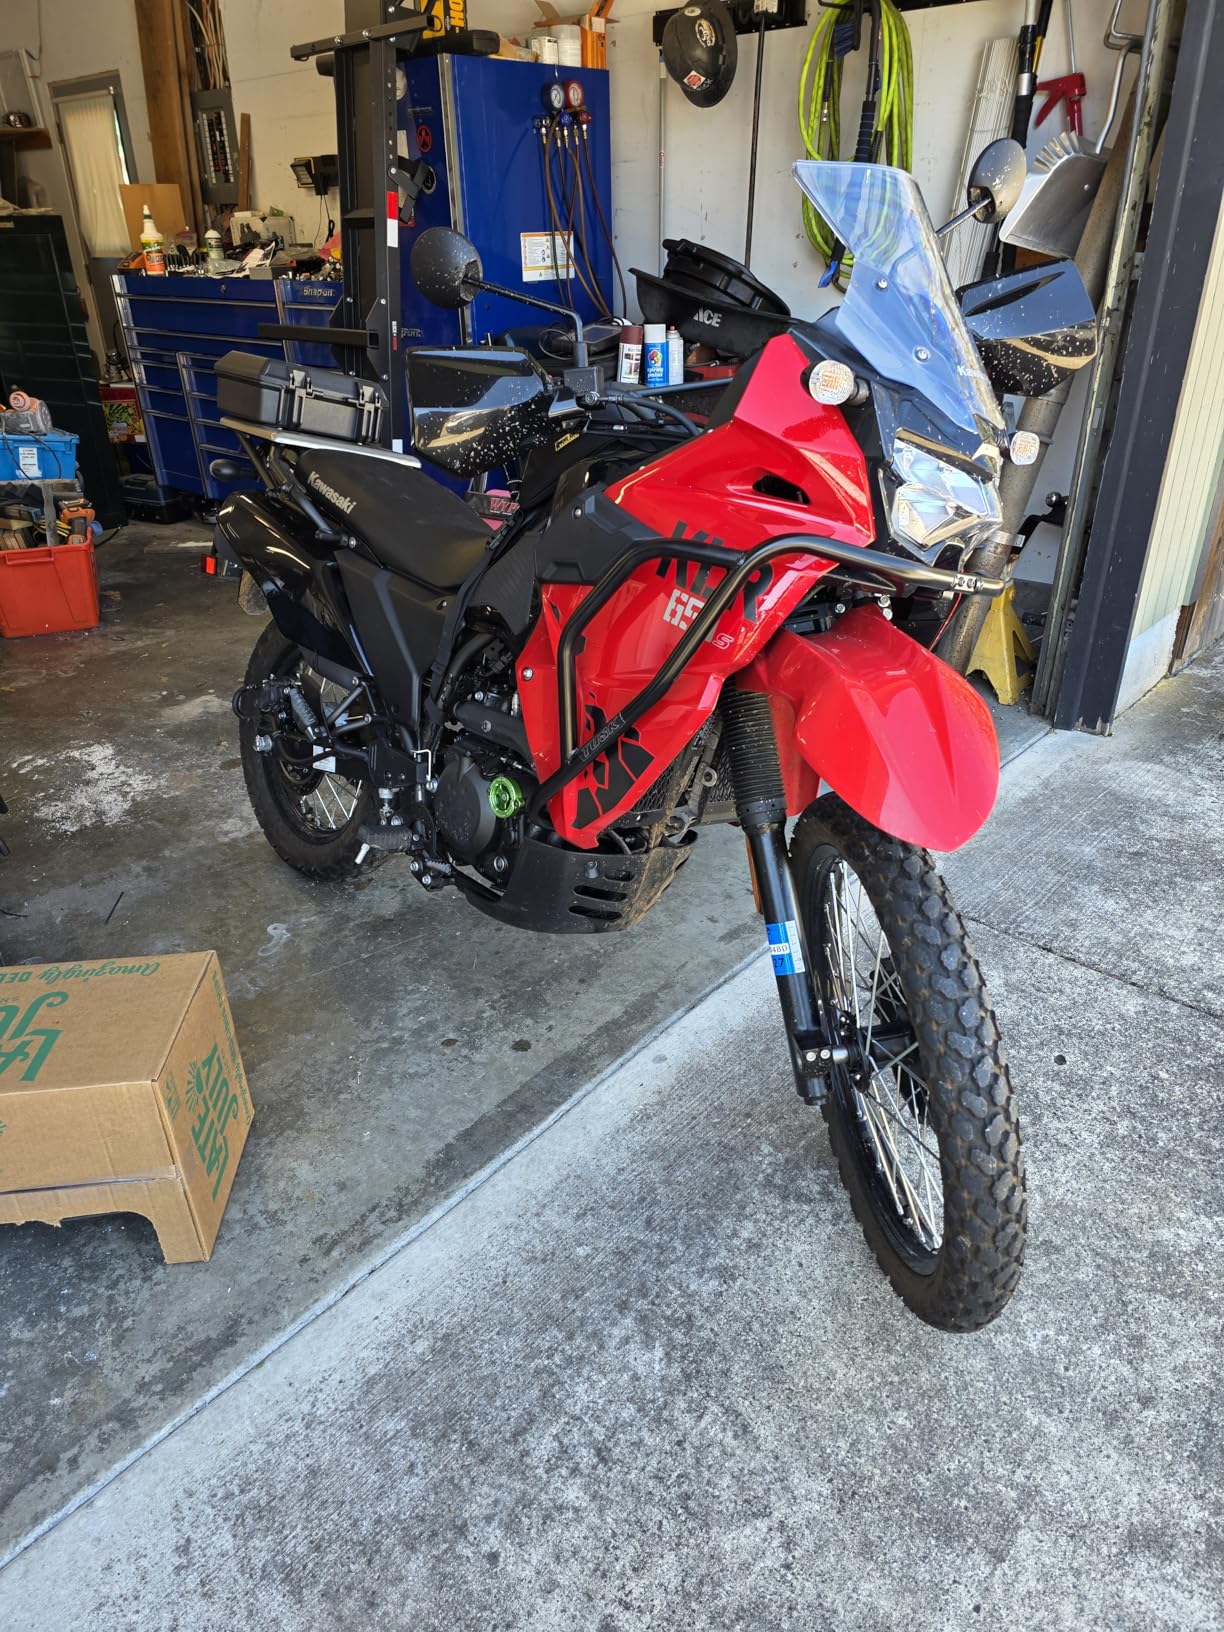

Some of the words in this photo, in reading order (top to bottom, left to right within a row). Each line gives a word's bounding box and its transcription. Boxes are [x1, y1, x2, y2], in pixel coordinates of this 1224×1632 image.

[693, 307, 722, 327] ACE
[307, 471, 357, 514] Kawasaki
[662, 588, 720, 643] 65
[582, 716, 620, 758] TUSK
[38, 960, 161, 984] Amazingly
[201, 1041, 239, 1136] JULY
[191, 1095, 229, 1201] LATE
